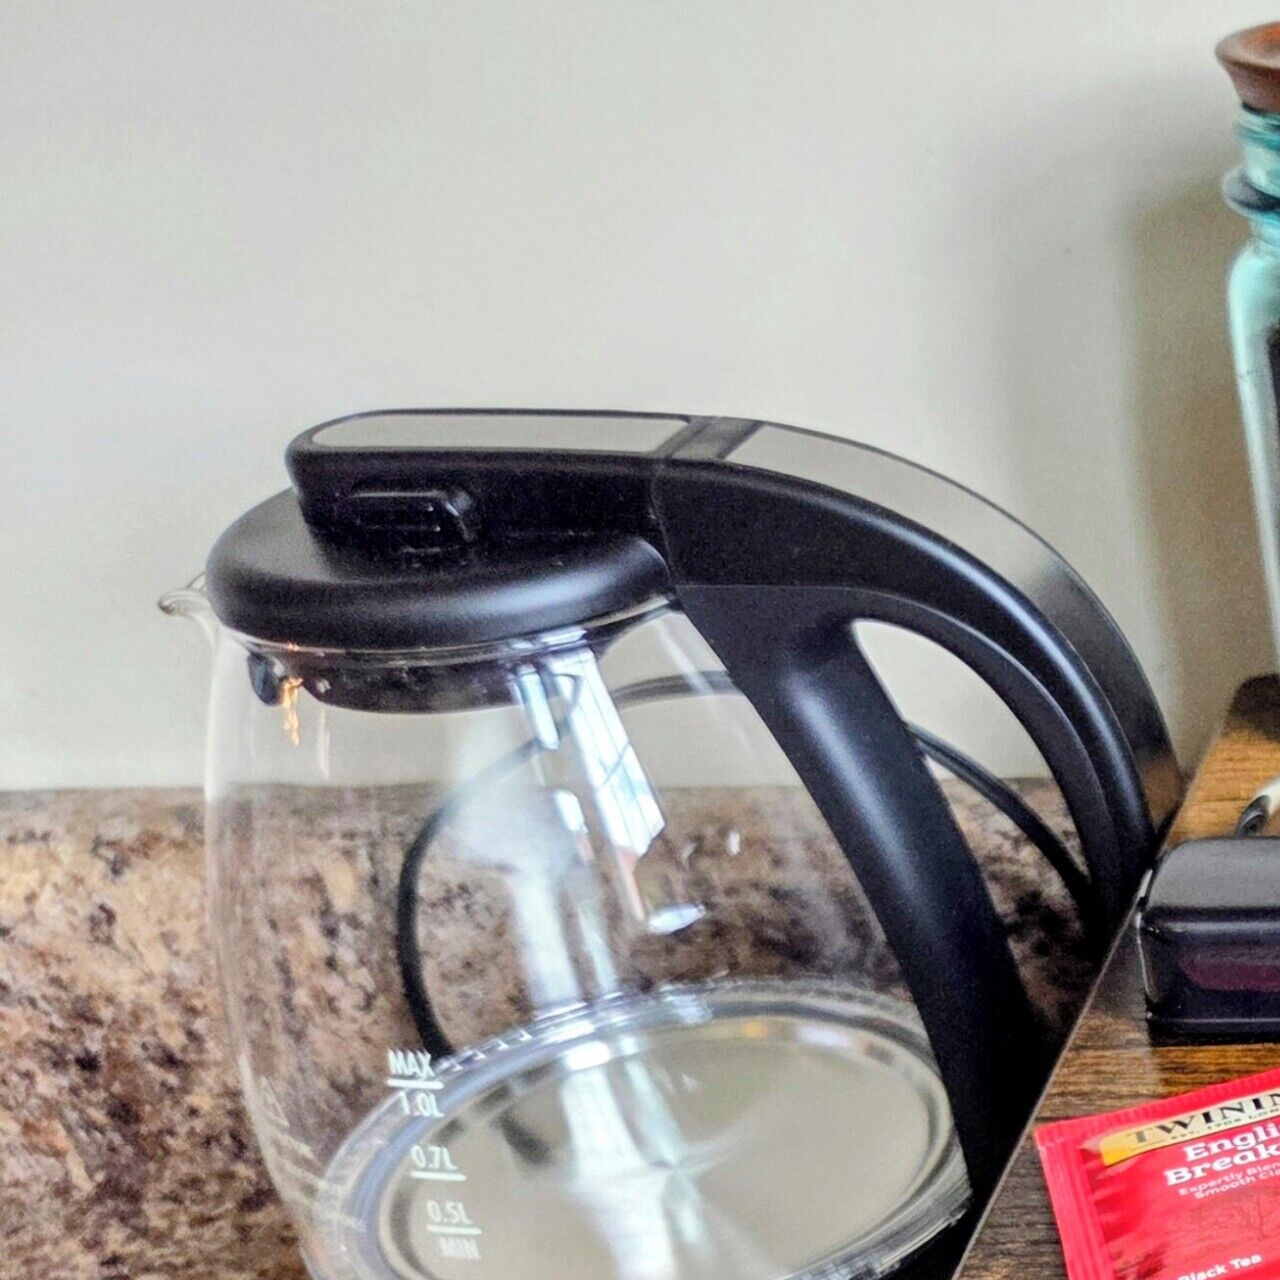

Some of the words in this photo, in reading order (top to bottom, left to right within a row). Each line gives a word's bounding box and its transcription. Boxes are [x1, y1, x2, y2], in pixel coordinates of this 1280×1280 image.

[388, 1050, 435, 1077] MAX
[411, 1144, 457, 1169] 0.7L
[1178, 1171, 1243, 1196] Expertly
[1194, 1177, 1256, 1199] Smooth
[427, 1199, 473, 1225] 0.5L
[1229, 1252, 1262, 1271] Tea
